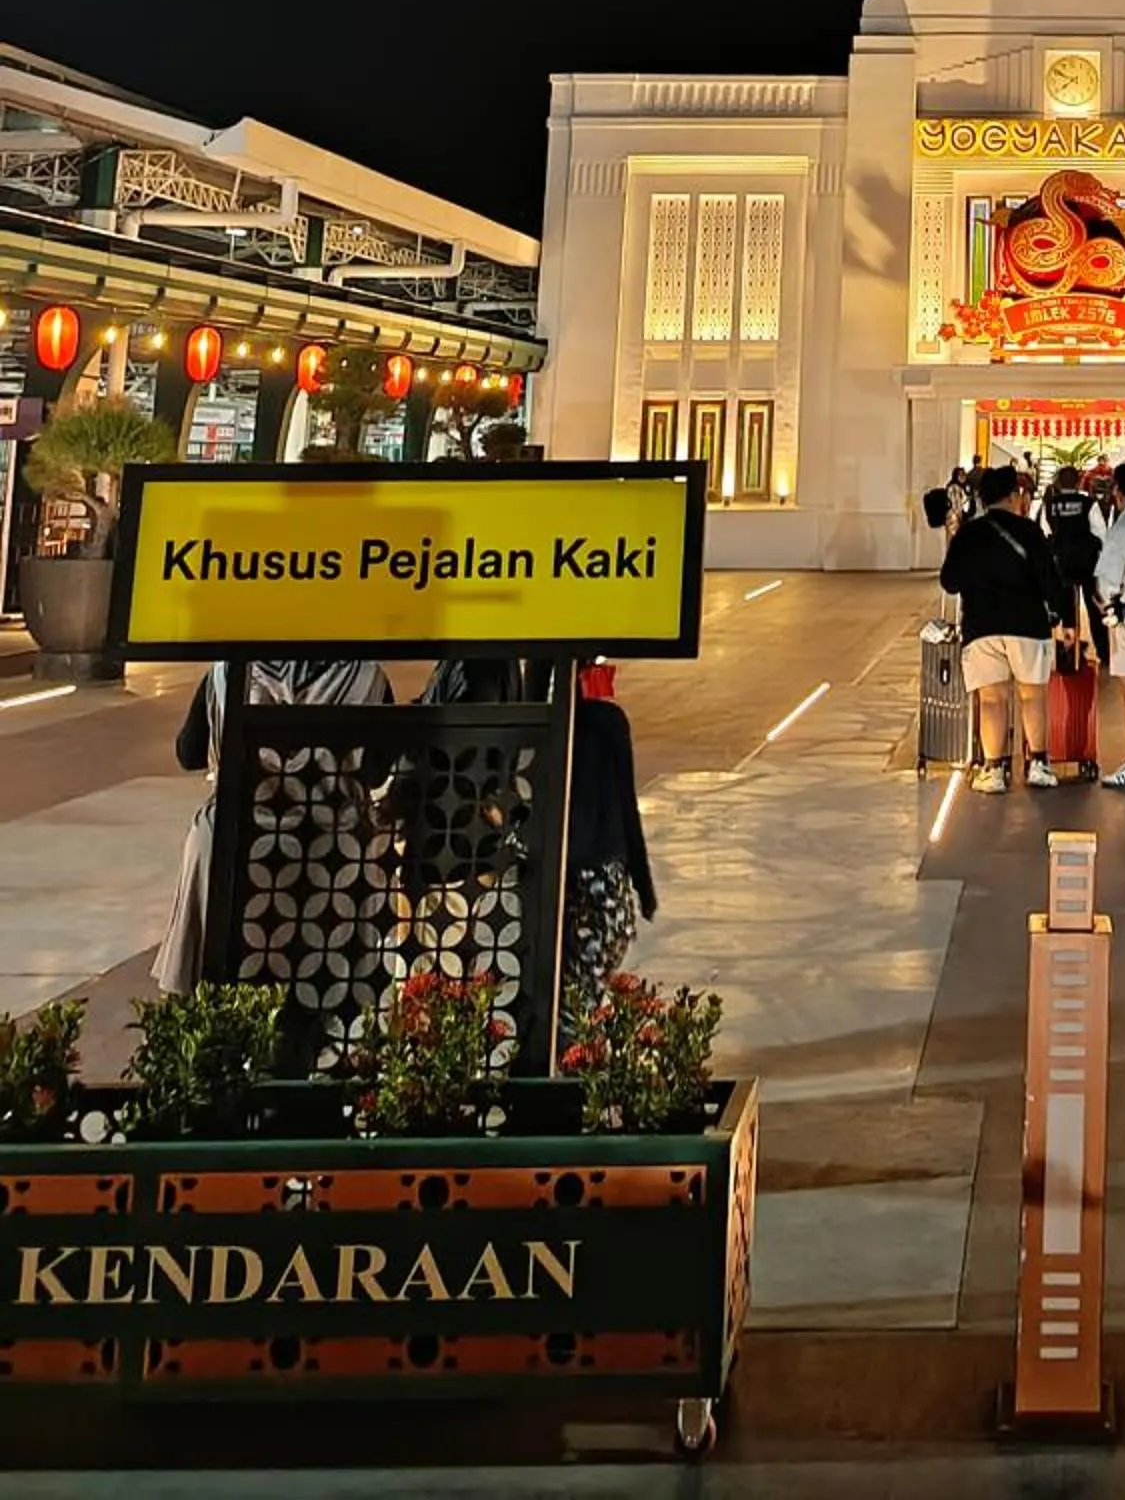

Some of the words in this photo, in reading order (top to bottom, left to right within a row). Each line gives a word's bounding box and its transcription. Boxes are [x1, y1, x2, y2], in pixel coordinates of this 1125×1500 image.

[163, 540, 341, 580] Khusus
[359, 538, 533, 589] Pejalan
[552, 536, 656, 578] Kaki
[15, 1241, 582, 1303] KENDARAAN
